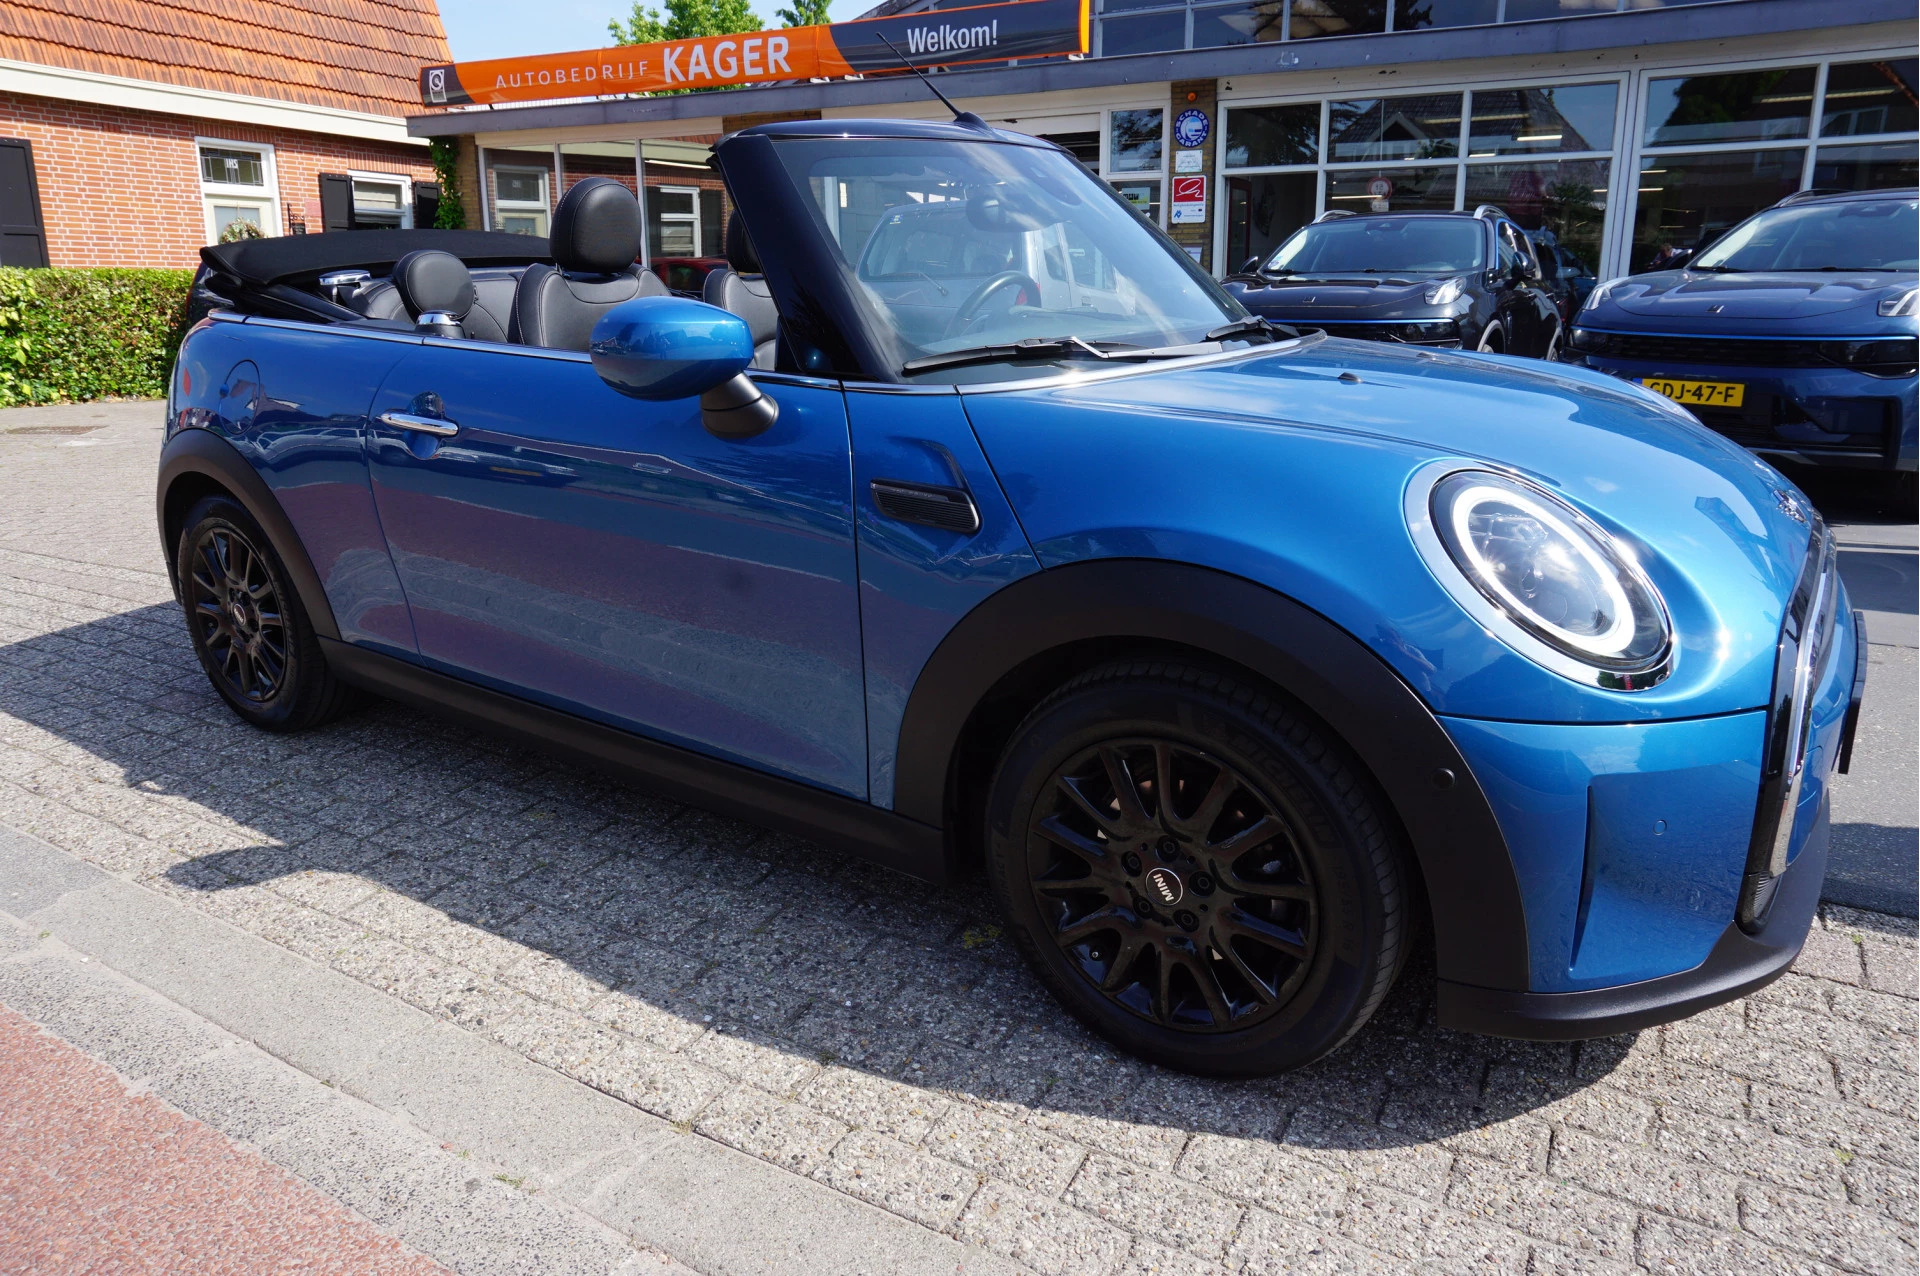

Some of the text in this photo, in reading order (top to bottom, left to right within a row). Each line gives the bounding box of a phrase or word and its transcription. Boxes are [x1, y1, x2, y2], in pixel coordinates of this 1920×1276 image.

[907, 19, 998, 53] Welkom!
[496, 36, 792, 89] AUTOBEDRIJF KAGER
[1175, 110, 1209, 127] SCHADE
[1175, 131, 1207, 147] GARANT
[1153, 873, 1175, 902] MINI
